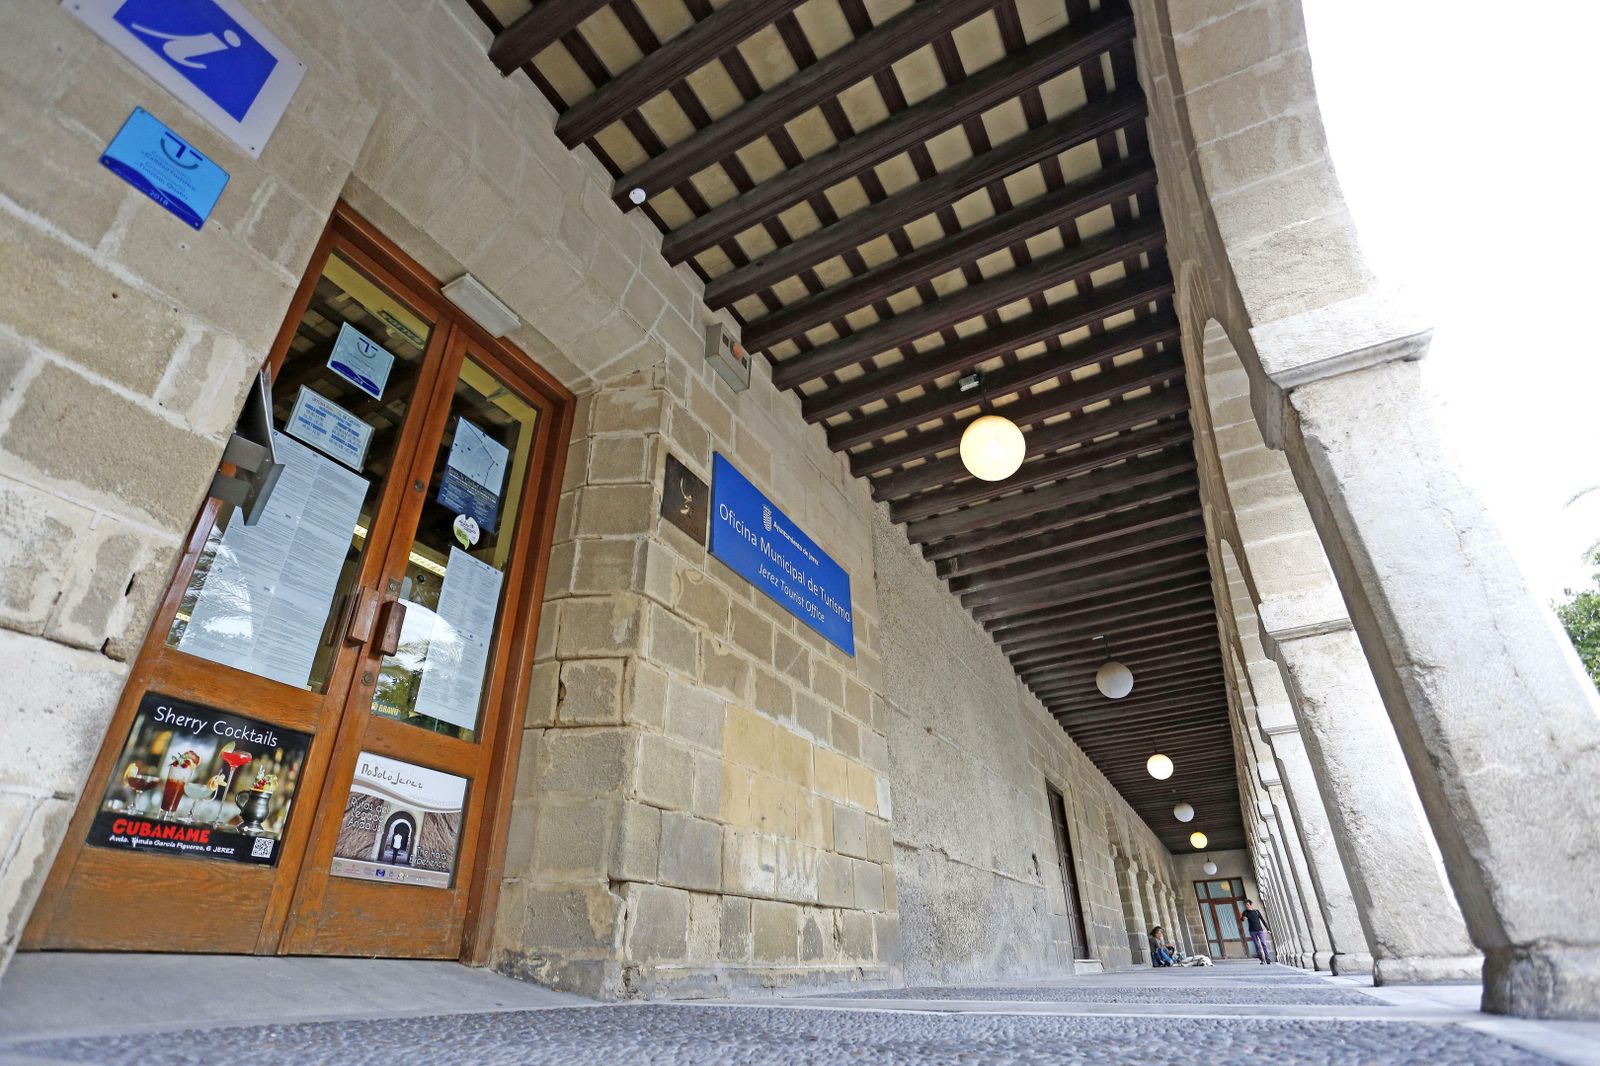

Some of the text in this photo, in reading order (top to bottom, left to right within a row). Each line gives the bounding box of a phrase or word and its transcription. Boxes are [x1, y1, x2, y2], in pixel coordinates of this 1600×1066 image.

[719, 503, 850, 623] Oficina Municipal de Turismo
[758, 563, 825, 623] Jerez Tourist Office
[154, 706, 279, 748] Sherry Cocktails
[112, 818, 211, 843] CUBANAME
[154, 839, 176, 848] García
